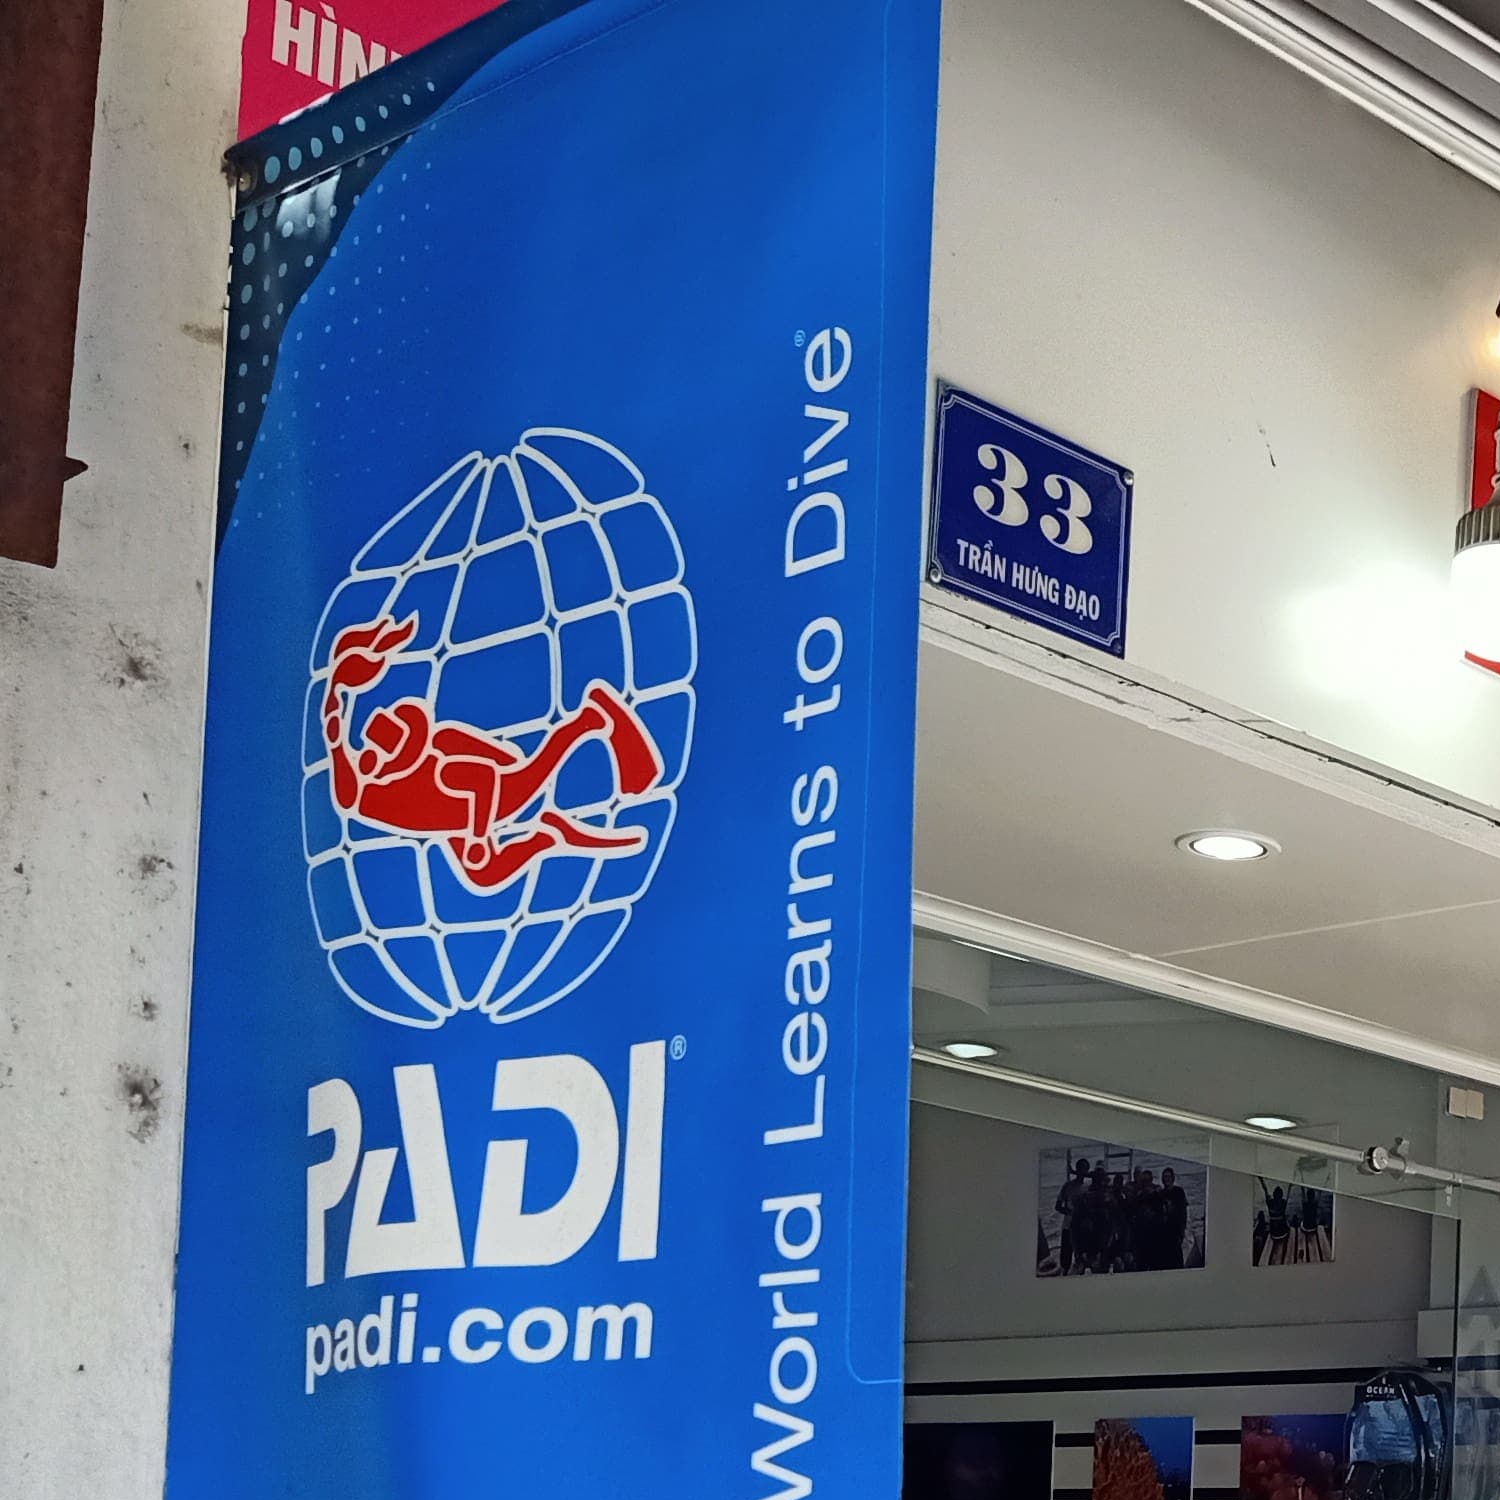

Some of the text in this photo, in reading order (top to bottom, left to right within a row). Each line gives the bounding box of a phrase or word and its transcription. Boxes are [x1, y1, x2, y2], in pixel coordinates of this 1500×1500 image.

[784, 326, 853, 578] Dive
[973, 443, 1094, 555] 33
[956, 538, 1101, 621] TRẦN HƯNG ĐẠO
[783, 616, 844, 731] to
[763, 765, 839, 1146] Learns
[305, 1293, 654, 1395] padi.com
[1366, 1386, 1395, 1395] OCEAN
